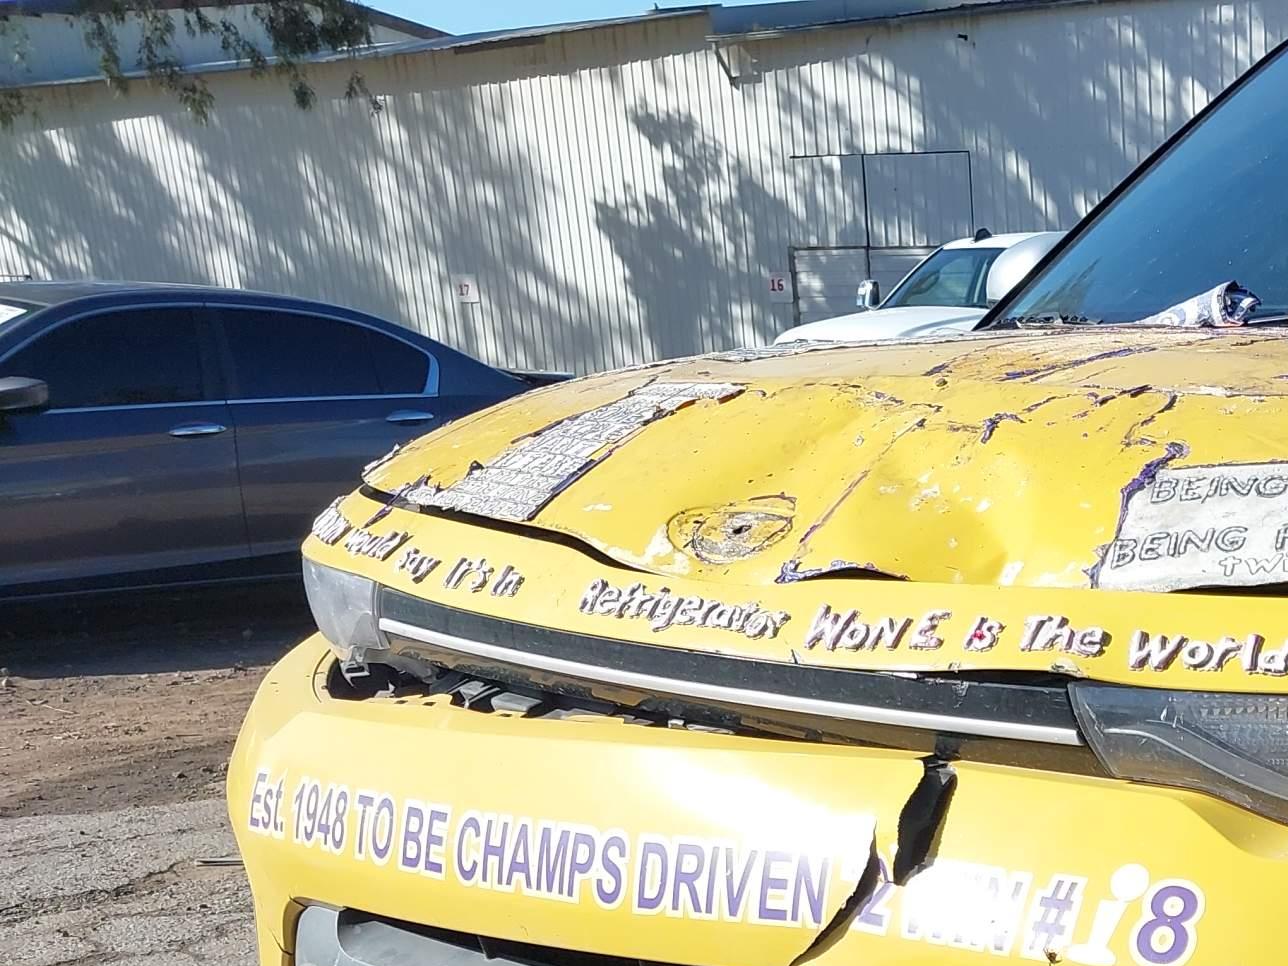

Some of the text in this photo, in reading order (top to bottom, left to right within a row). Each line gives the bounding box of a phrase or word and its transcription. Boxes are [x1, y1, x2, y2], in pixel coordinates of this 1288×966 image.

[458, 284, 470, 297] 17
[769, 279, 784, 292] 16
[1149, 474, 1288, 504] BEING
[1110, 525, 1249, 570] BEING
[580, 579, 792, 639] Refrigerator
[1019, 615, 1112, 658] The
[249, 773, 286, 831] Est.
[294, 782, 348, 849] 1948
[357, 795, 393, 860] TO
[402, 806, 448, 874] BE
[457, 816, 626, 905] CHAMPS
[637, 842, 829, 925] DRIVEN
